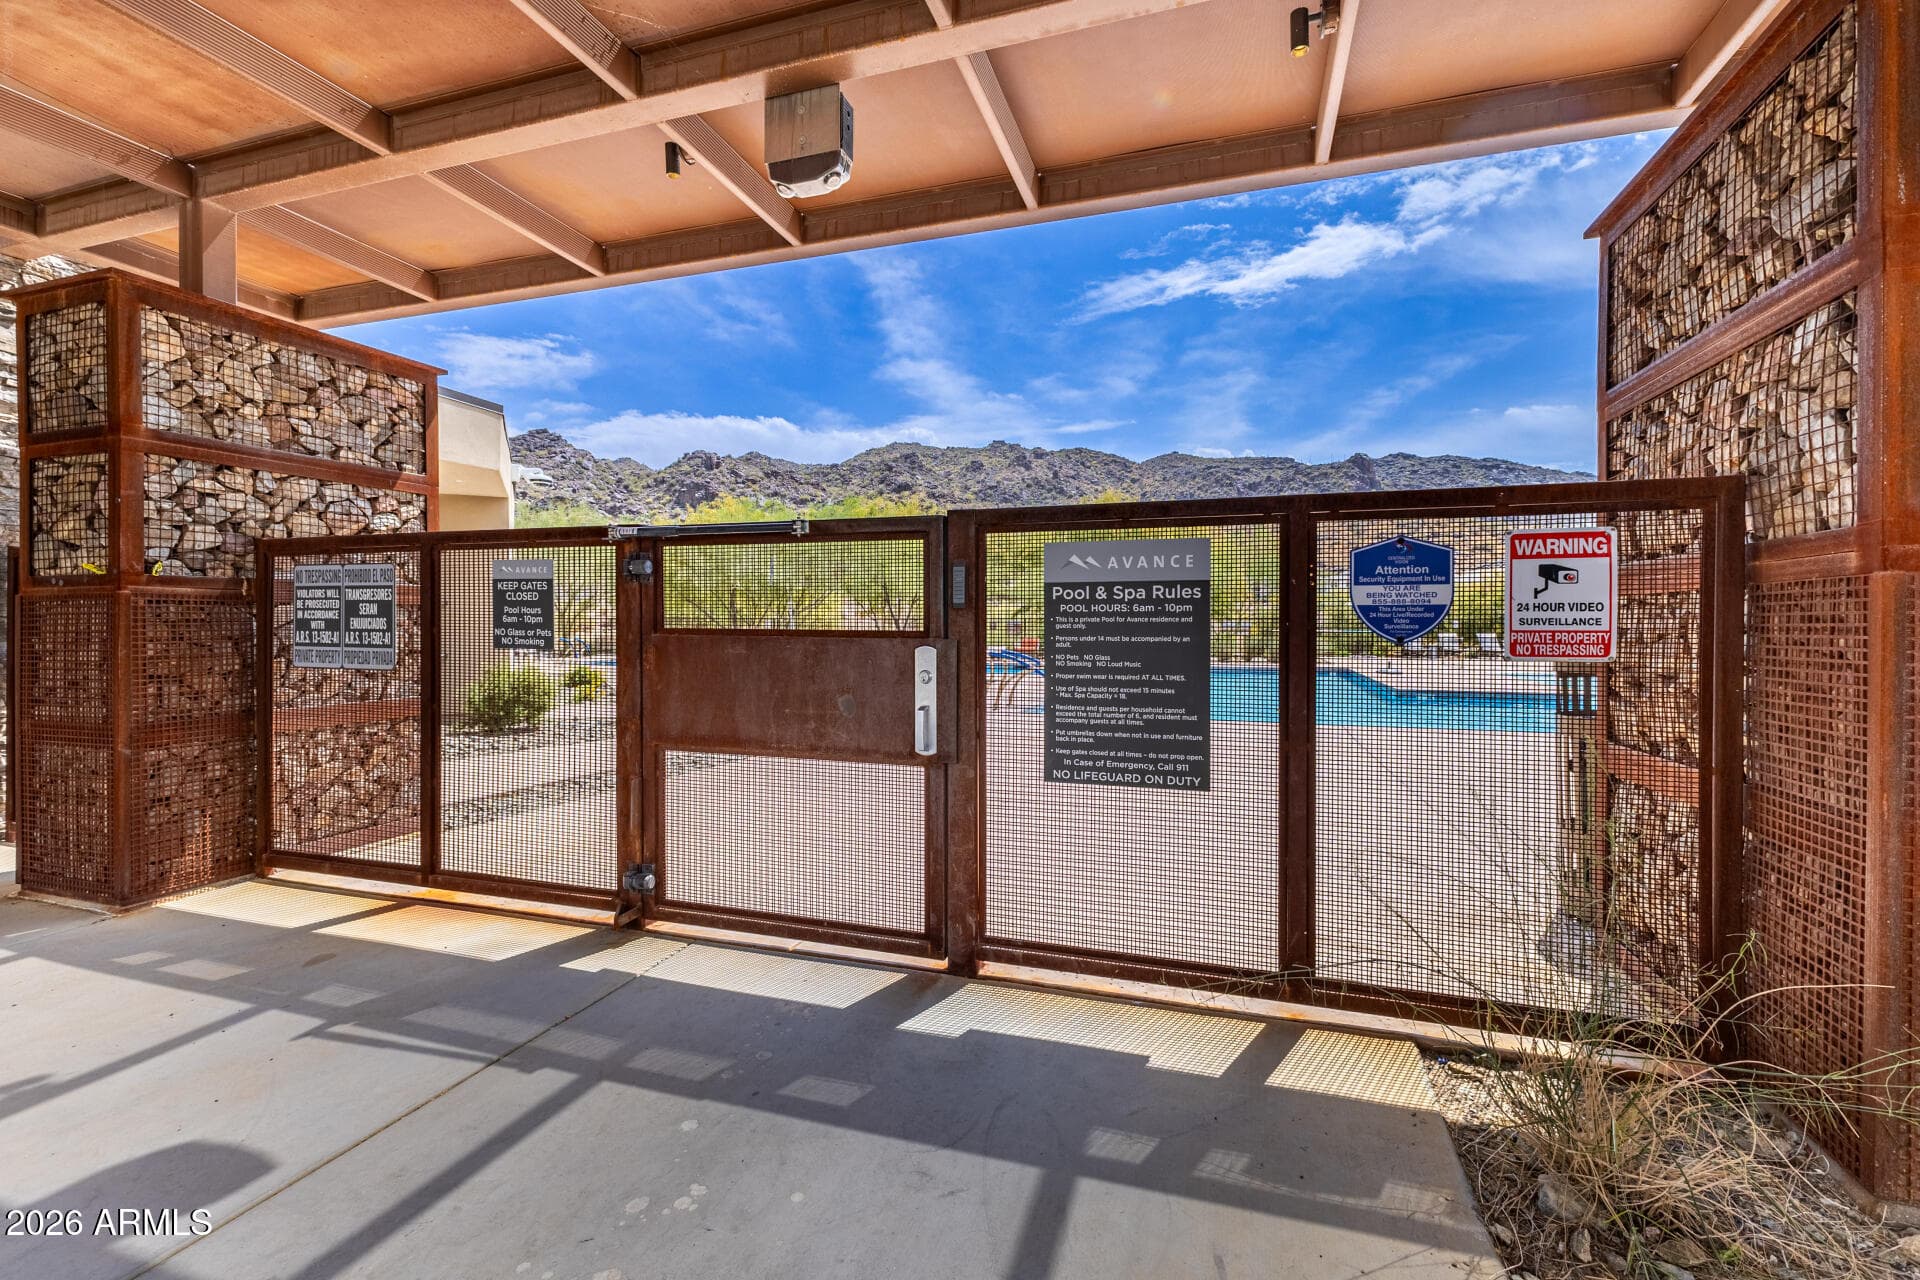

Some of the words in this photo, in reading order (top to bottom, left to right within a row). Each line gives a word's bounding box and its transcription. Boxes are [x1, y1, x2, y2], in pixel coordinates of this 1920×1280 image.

[1515, 537, 1607, 555] WARNING
[1108, 555, 1194, 568] AVANCE
[1376, 565, 1428, 574] Attention
[296, 570, 303, 583] NO
[304, 570, 340, 584] TRESPASSING
[345, 569, 371, 582] PROHIBIDO
[373, 569, 377, 582] EL
[380, 569, 393, 582] PASO
[297, 590, 325, 598] VIOLATORS
[345, 589, 392, 600] TRANSGRESORES
[1053, 586, 1089, 600] Pool
[1096, 586, 1107, 599] &
[1113, 586, 1146, 601] Spa
[1152, 585, 1201, 599] Rules
[297, 600, 303, 608] BE
[305, 600, 339, 608] PROSECUTED
[359, 603, 377, 615] SERAN
[1060, 604, 1088, 612] POOL
[1133, 604, 1154, 612] 6am
[1165, 603, 1192, 613] 10pm
[1517, 603, 1528, 611] 24
[1533, 603, 1565, 612] HOUR
[1568, 603, 1604, 612] VIDEO
[304, 610, 339, 619] ACCORDANCE
[524, 616, 543, 624] 10pm
[311, 621, 325, 629] WITH
[296, 631, 310, 642] A.R.S.
[345, 632, 360, 644] A.R.S.
[515, 638, 544, 646] Smoking
[1512, 632, 1552, 643] PRIVATE
[1555, 633, 1610, 644] PROPERTY
[1516, 644, 1531, 654] NO
[1534, 644, 1604, 655] TRESPASSING
[1107, 760, 1155, 770] Emergency,
[1053, 770, 1070, 779] NO
[1074, 771, 1141, 782] LIFEGUARD
[1145, 774, 1163, 784] ON
[1168, 776, 1200, 786] DUTY
